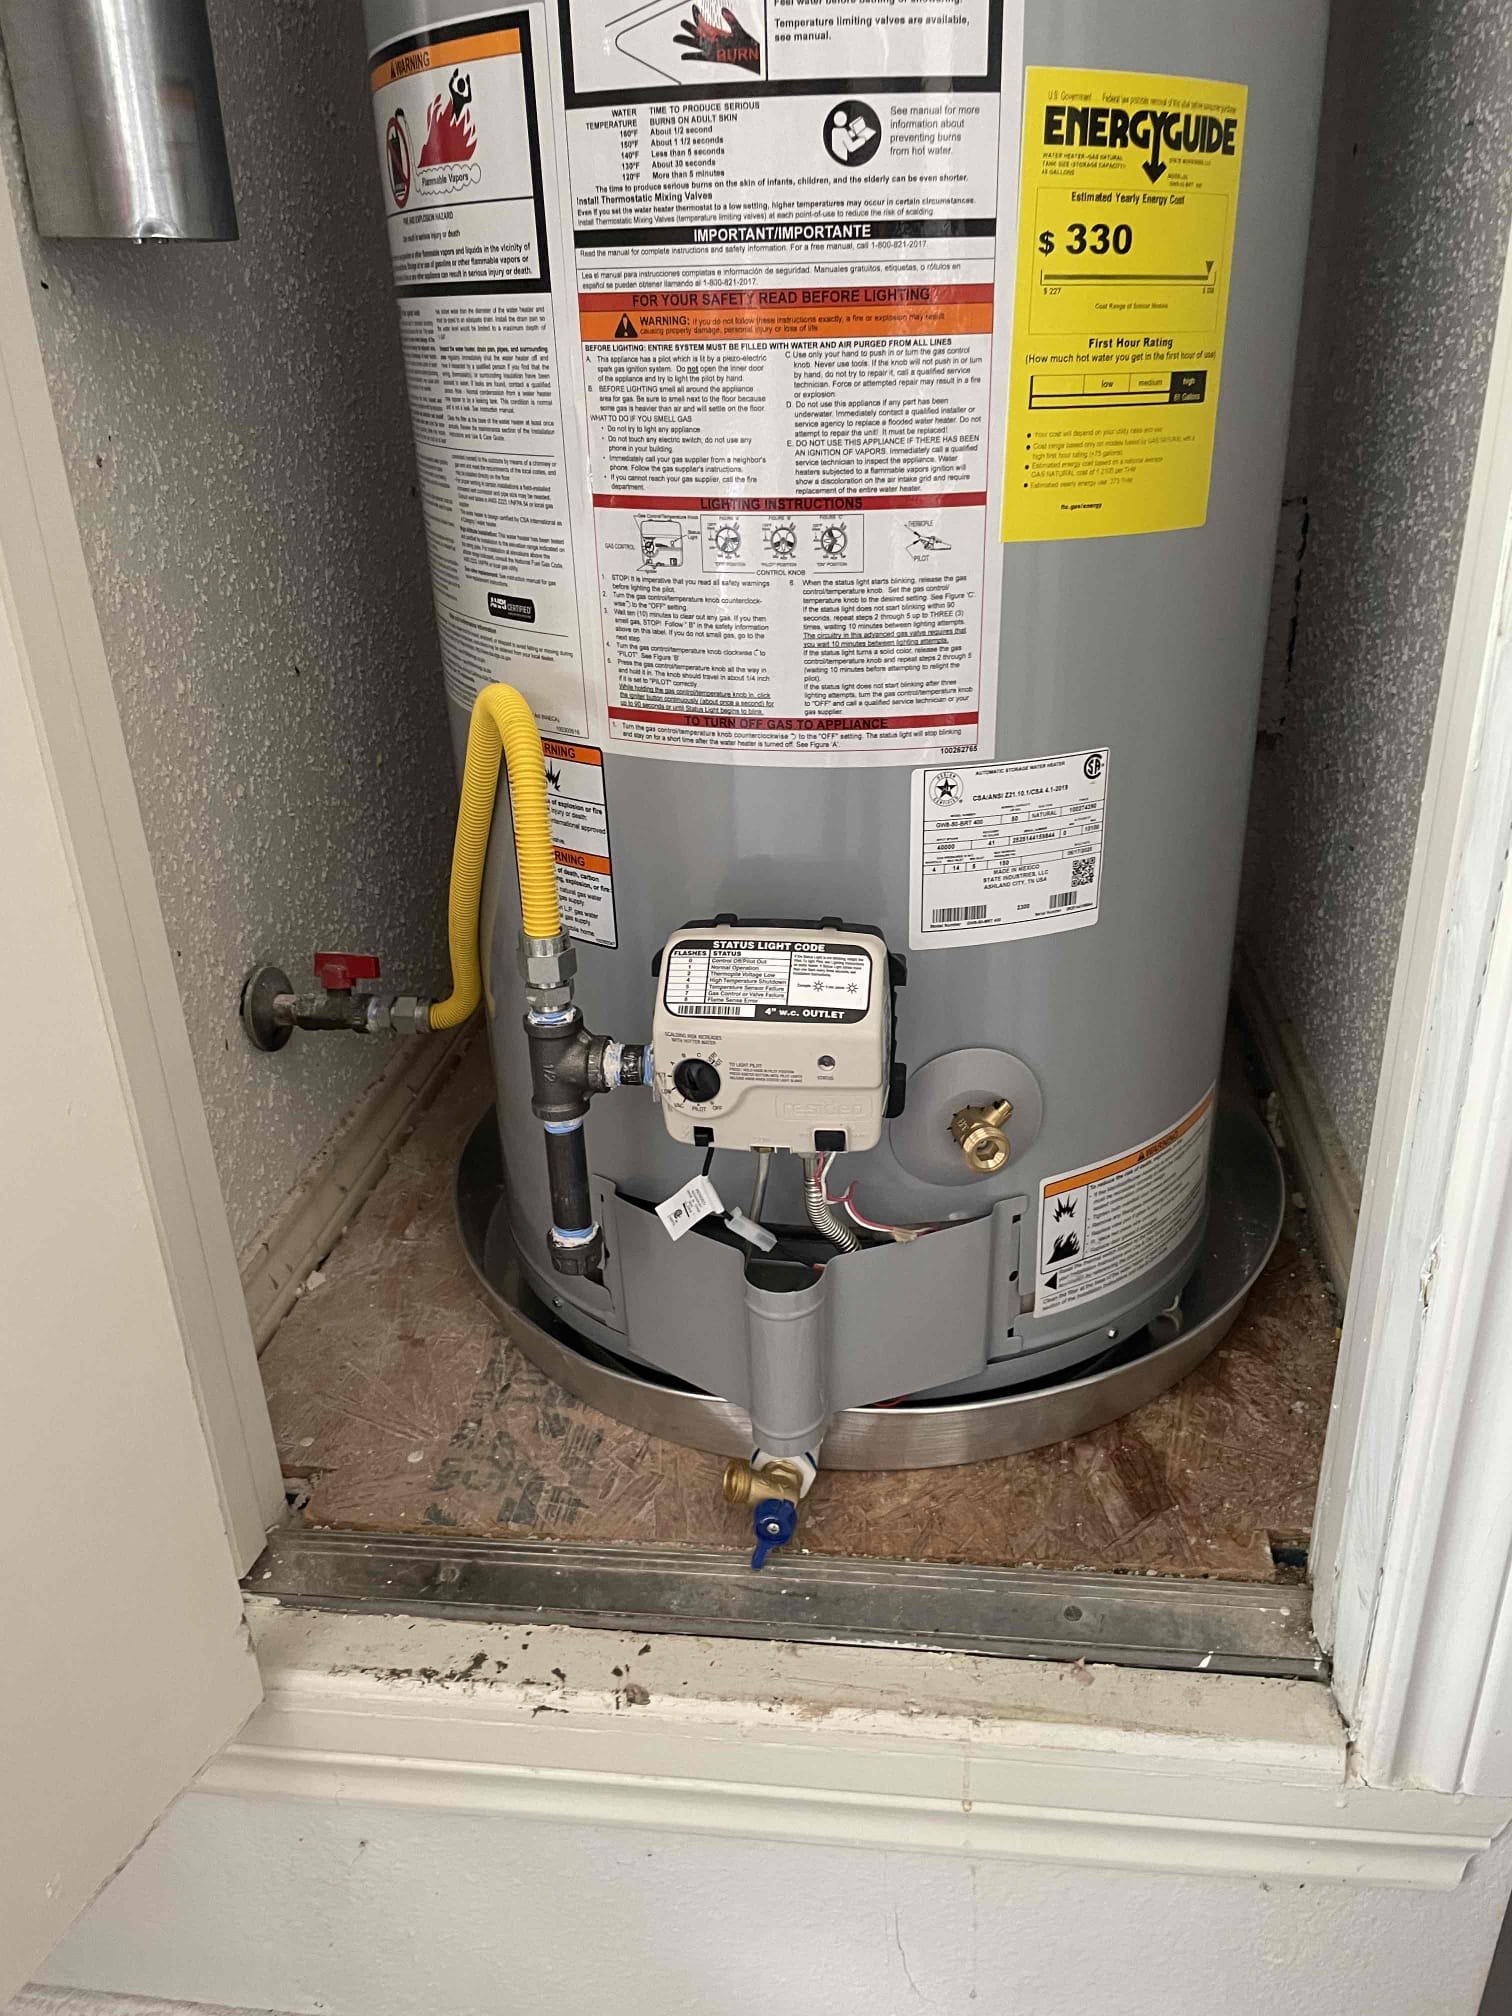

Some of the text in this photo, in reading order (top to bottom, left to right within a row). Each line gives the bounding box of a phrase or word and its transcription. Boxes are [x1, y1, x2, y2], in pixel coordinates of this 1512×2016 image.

[774, 18, 834, 27] Temperature
[836, 16, 872, 26] limiting
[875, 16, 905, 24] valves
[925, 15, 969, 24] available,
[794, 31, 831, 40] manual.
[716, 46, 760, 62] BURN
[394, 52, 431, 78] WARNING
[611, 108, 636, 116] WATER
[649, 101, 759, 114] TIME TO PRODUCE SERIOUS
[890, 105, 908, 115] See
[910, 106, 942, 114] manual
[944, 105, 956, 114] for
[586, 119, 637, 129] TEMPERATURE
[649, 113, 737, 125] BURNS ON ADULT SKIN
[890, 118, 964, 128] information about
[1043, 105, 1238, 156] ENERGYGUIDE
[890, 133, 961, 143] preventing burns
[890, 146, 909, 155] from
[911, 145, 925, 155] hot
[448, 172, 469, 184] Vapors
[576, 191, 712, 204] Install Thermostatic Mixing Valves
[1071, 192, 1185, 205] Estimated Yearly Energy Cost
[694, 224, 870, 242] IMPORTANT/IMPORTANTE
[1038, 224, 1133, 256] $ 330
[632, 288, 930, 306] FOR YOUR SAFETY READ BEFORE LIGHTING
[639, 315, 693, 325] WARNING:
[1088, 337, 1173, 348] First Hour Rating
[1025, 354, 1048, 364] (How
[1050, 354, 1073, 362] much
[1076, 353, 1089, 362] hot
[1115, 354, 1129, 363] you
[1131, 353, 1143, 363] get
[1153, 352, 1164, 360] the
[1166, 351, 1179, 359] first
[1196, 350, 1203, 359] of
[1204, 351, 1216, 359] use)
[1101, 380, 1113, 388] low
[700, 497, 862, 510] LIGHTING INSTRUCTIONS
[684, 714, 889, 730] TO TURN OFF GAS TO APPLIANCE
[544, 744, 576, 758] RNING
[1032, 810, 1056, 818] NATURAL
[555, 852, 585, 867] RNING
[1018, 864, 1040, 872] MEXICO
[713, 940, 825, 953] STATUS LIGHT CODE
[802, 1009, 844, 1018] OUTLET
